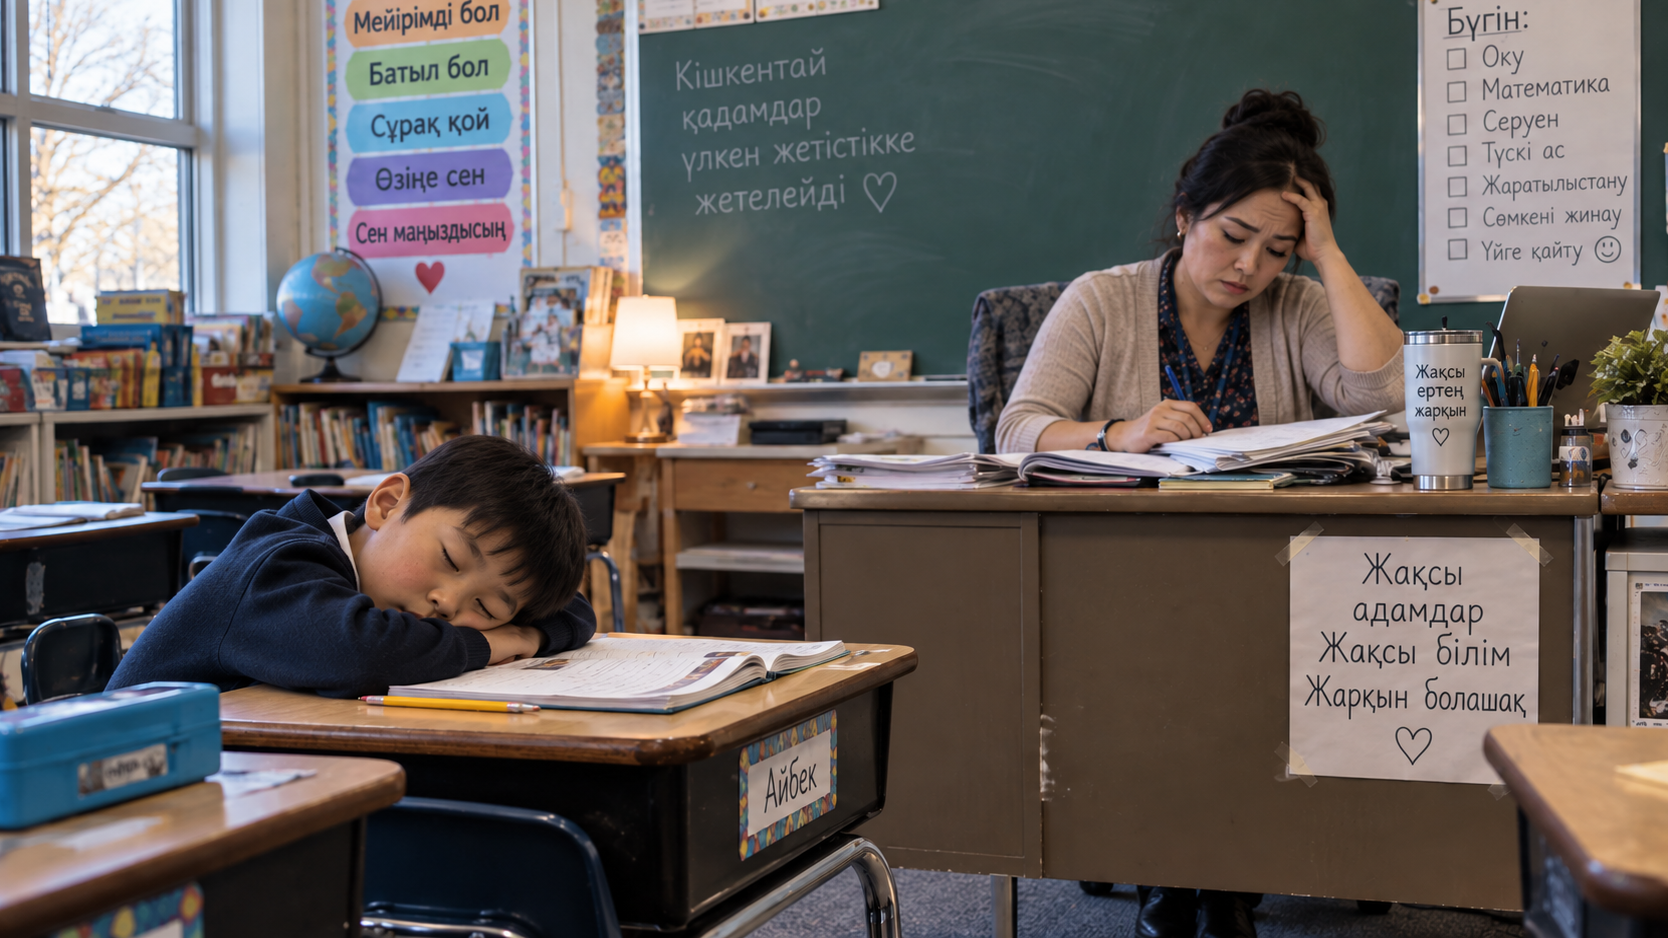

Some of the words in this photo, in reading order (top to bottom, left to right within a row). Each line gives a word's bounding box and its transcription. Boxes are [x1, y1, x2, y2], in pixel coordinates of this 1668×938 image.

[354, 3, 452, 35] Мейірімді
[460, 0, 500, 25] бол
[1448, 6, 1528, 41] Бүгін:
[369, 62, 438, 85] Батыл
[448, 54, 488, 79] бол
[676, 47, 825, 91] Кішкентай
[1482, 44, 1524, 74] Оку
[1482, 77, 1610, 100] Математика
[371, 114, 440, 143] Сұрақ
[448, 107, 489, 136] қой
[683, 97, 821, 134] қадамдар
[1483, 109, 1558, 138] Серуен
[681, 146, 759, 182] үлкен
[773, 127, 915, 164] жетістікке
[1482, 141, 1531, 168] Түскі
[1542, 144, 1565, 159] ас
[375, 167, 438, 192] Өзіңе
[447, 166, 485, 189] сен
[695, 174, 845, 215] жетелейді
[1482, 174, 1627, 201] Жаратылыстану
[356, 221, 388, 245] Сен
[394, 219, 506, 245] маңыздысың
[1483, 206, 1554, 227] Сөмкені
[1564, 208, 1621, 230] жинау
[1481, 240, 1521, 261] Үйге
[1531, 240, 1583, 266] қайту
[1415, 364, 1465, 380] Жақсы
[1417, 386, 1464, 401] ертең
[1415, 406, 1467, 421] жарқын
[1362, 553, 1461, 590] Жақсы
[1353, 602, 1484, 636] адамдар
[1319, 631, 1415, 669] Жақсы
[1436, 632, 1509, 666] білім
[1304, 675, 1407, 719] Жарқын
[1424, 676, 1526, 718] болашақ
[764, 756, 817, 814] Айбек
